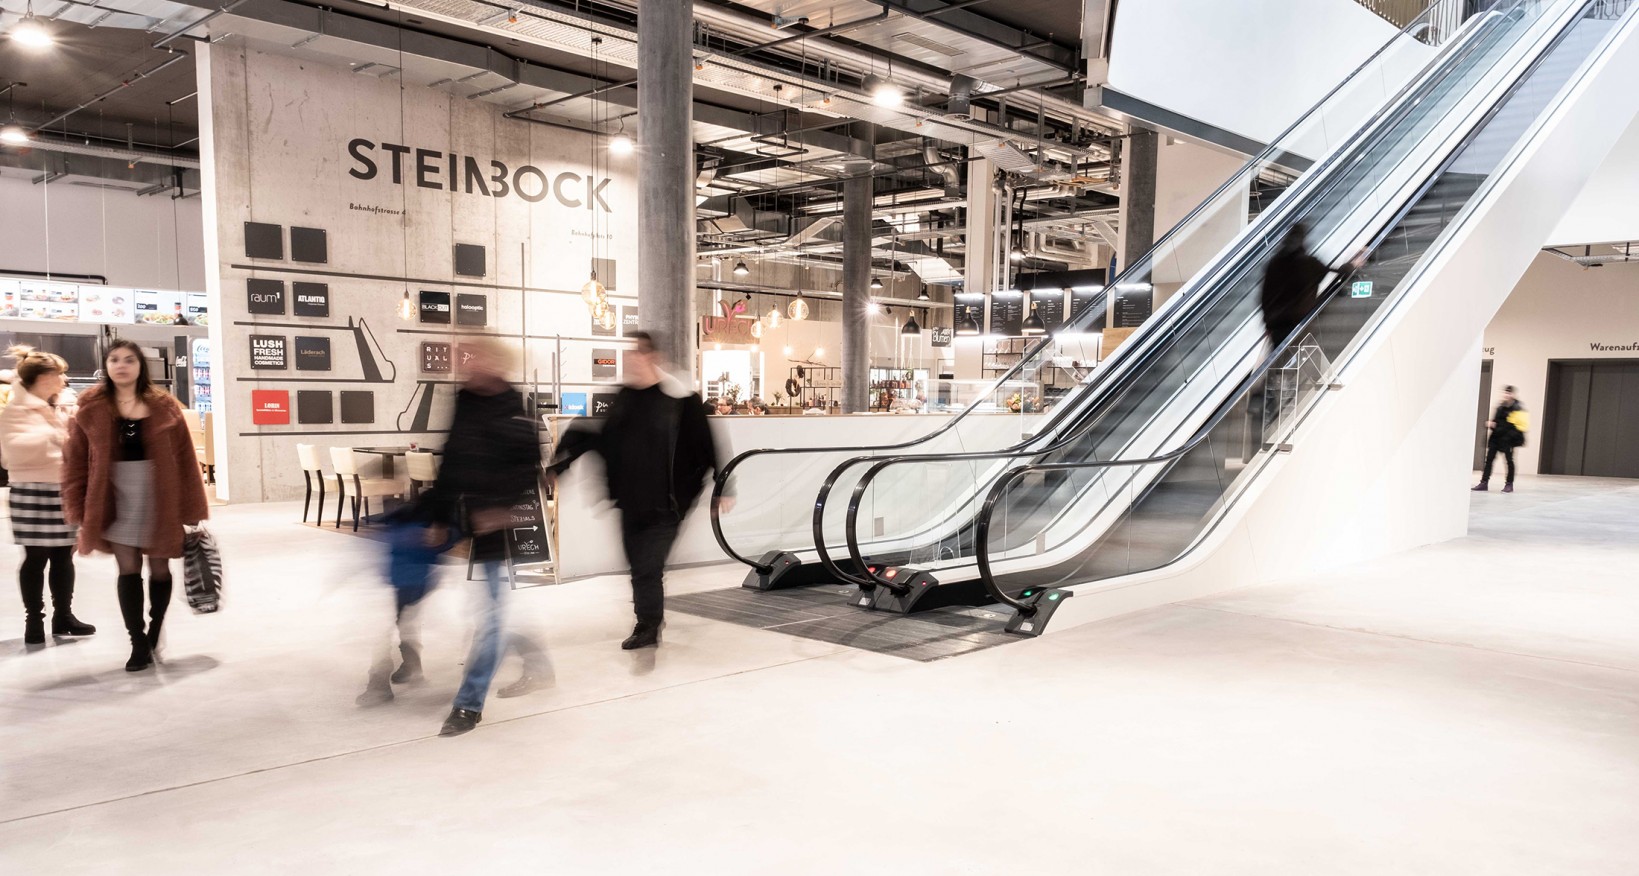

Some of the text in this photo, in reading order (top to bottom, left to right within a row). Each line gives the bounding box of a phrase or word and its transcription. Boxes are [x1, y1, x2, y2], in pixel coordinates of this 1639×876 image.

[347, 138, 613, 213] STEINBOCK
[349, 202, 400, 215] Bahnhofstrasse
[253, 340, 283, 348] LUSH
